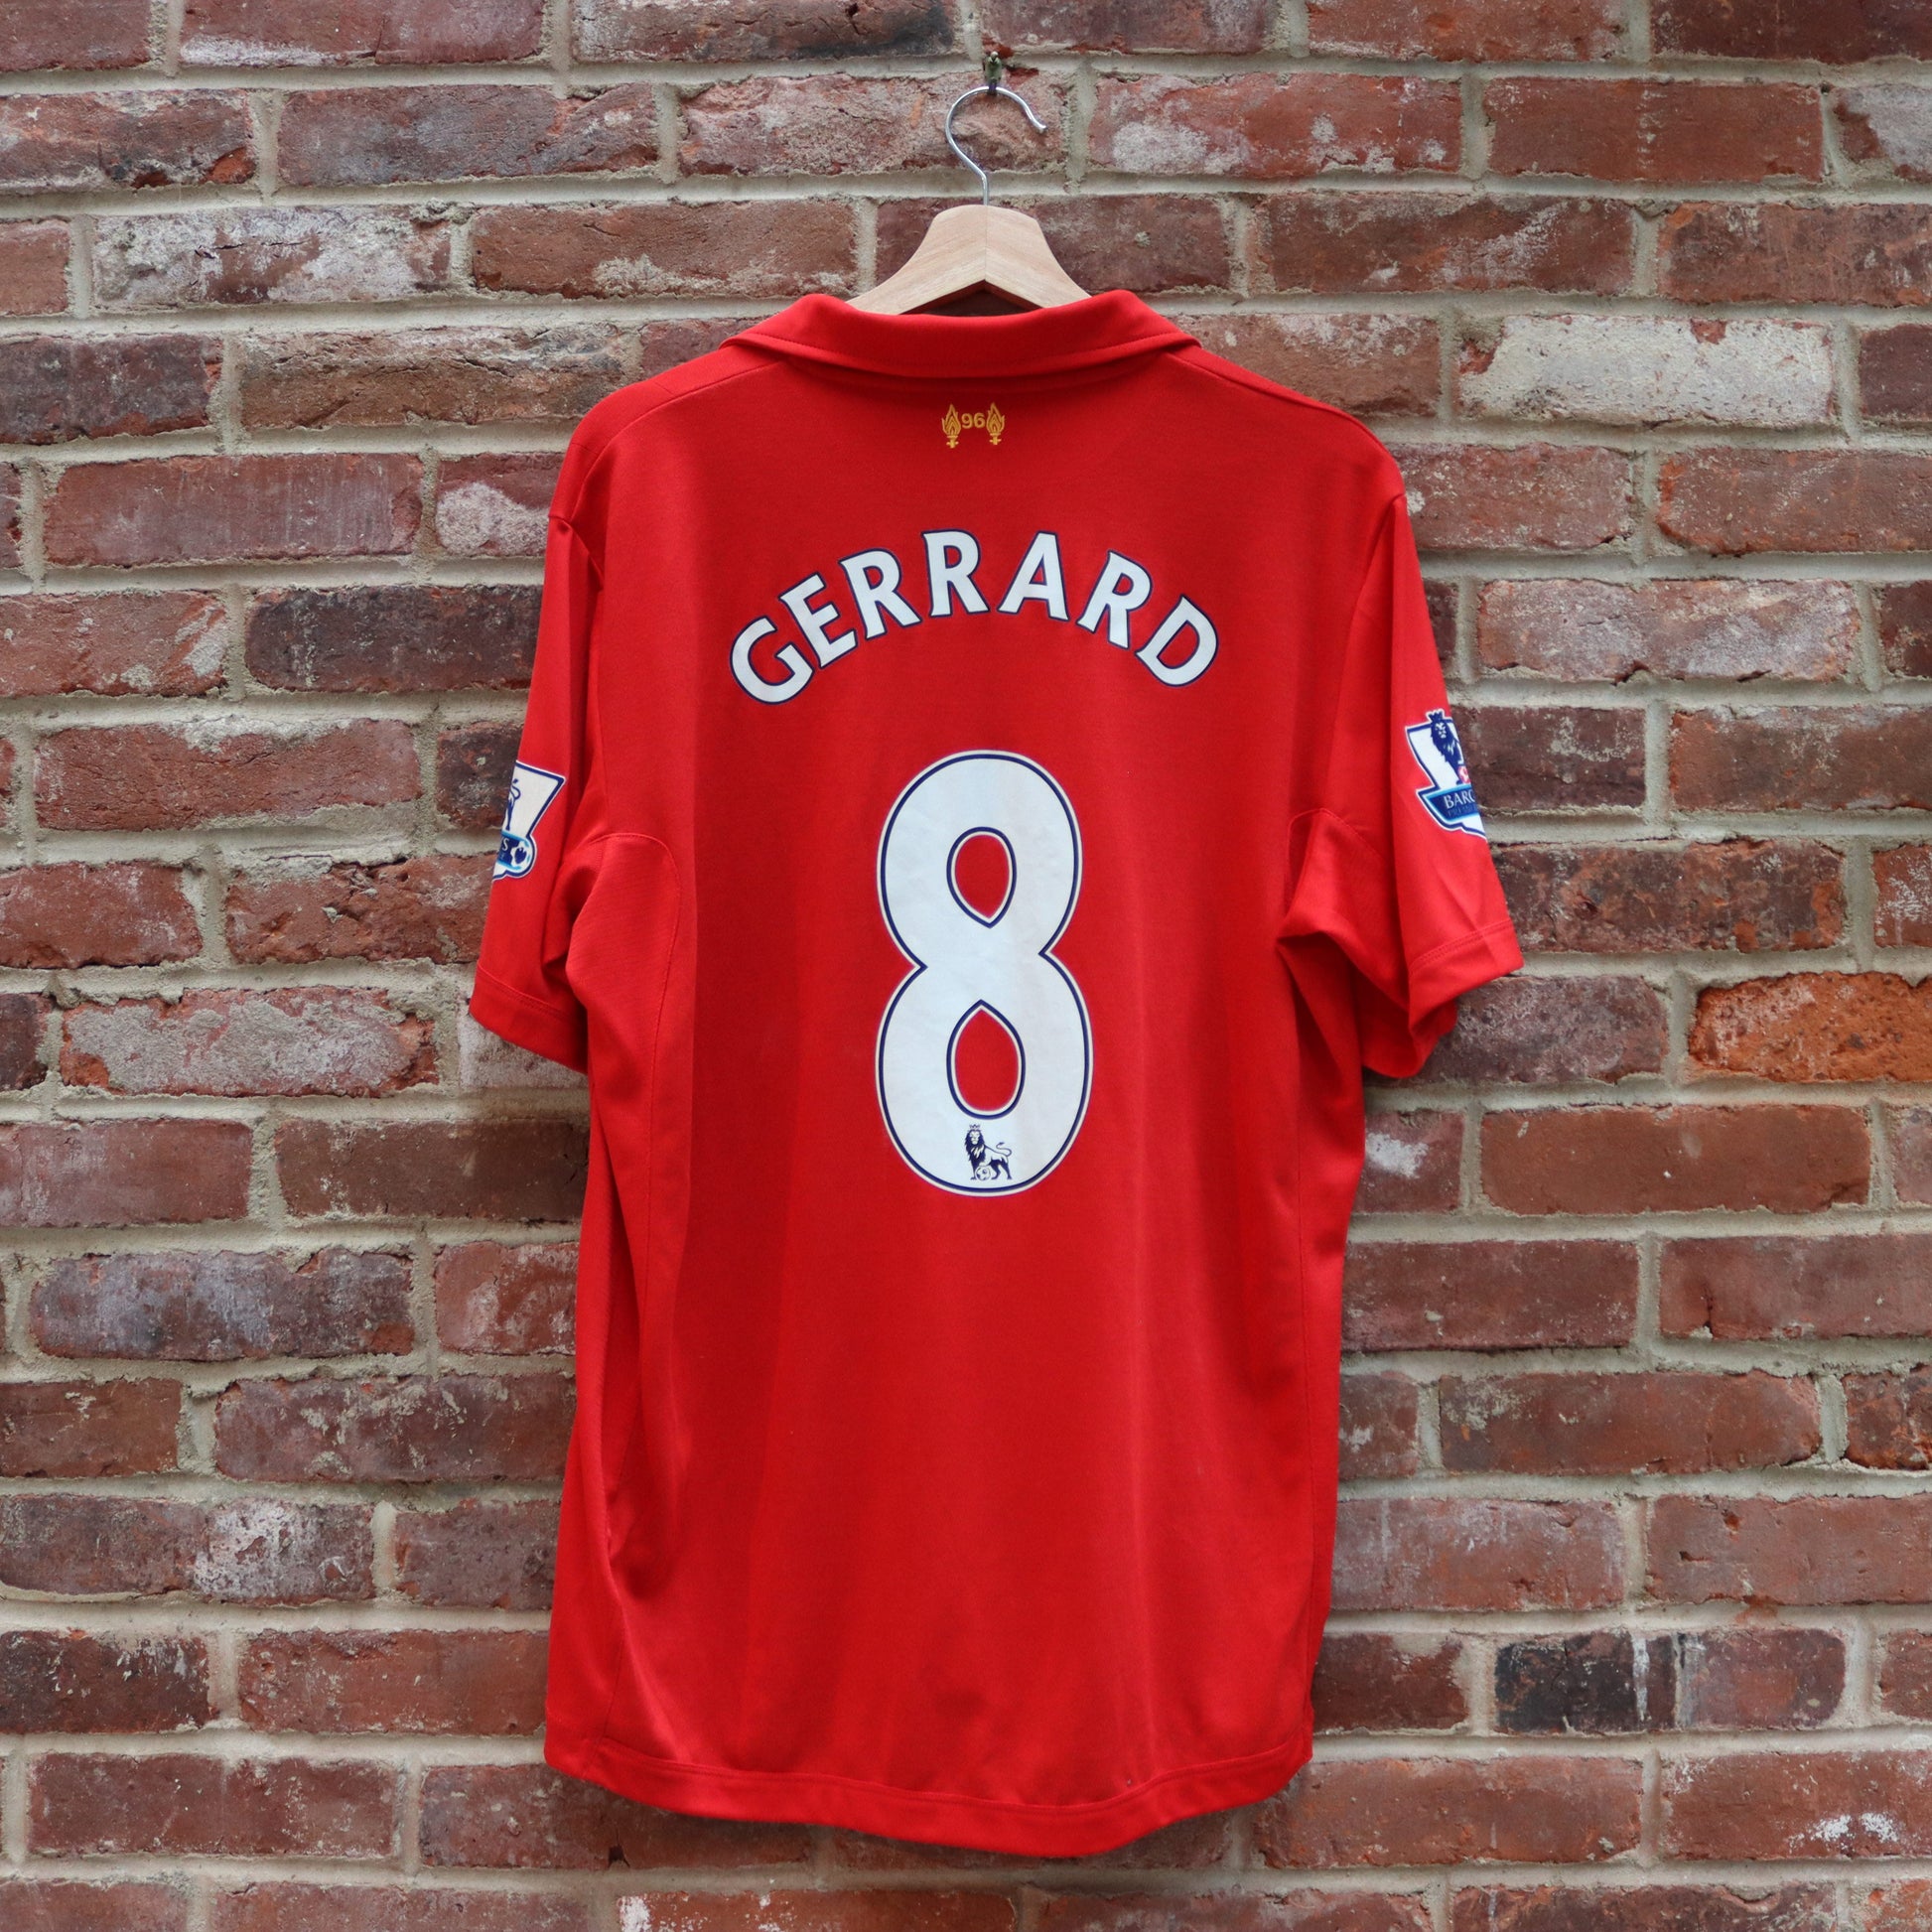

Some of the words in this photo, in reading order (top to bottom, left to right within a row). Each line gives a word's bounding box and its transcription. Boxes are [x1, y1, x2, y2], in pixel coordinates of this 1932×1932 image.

[961, 413, 986, 429] 96
[730, 528, 1219, 706] GERRARD
[875, 749, 1094, 1198] 8
